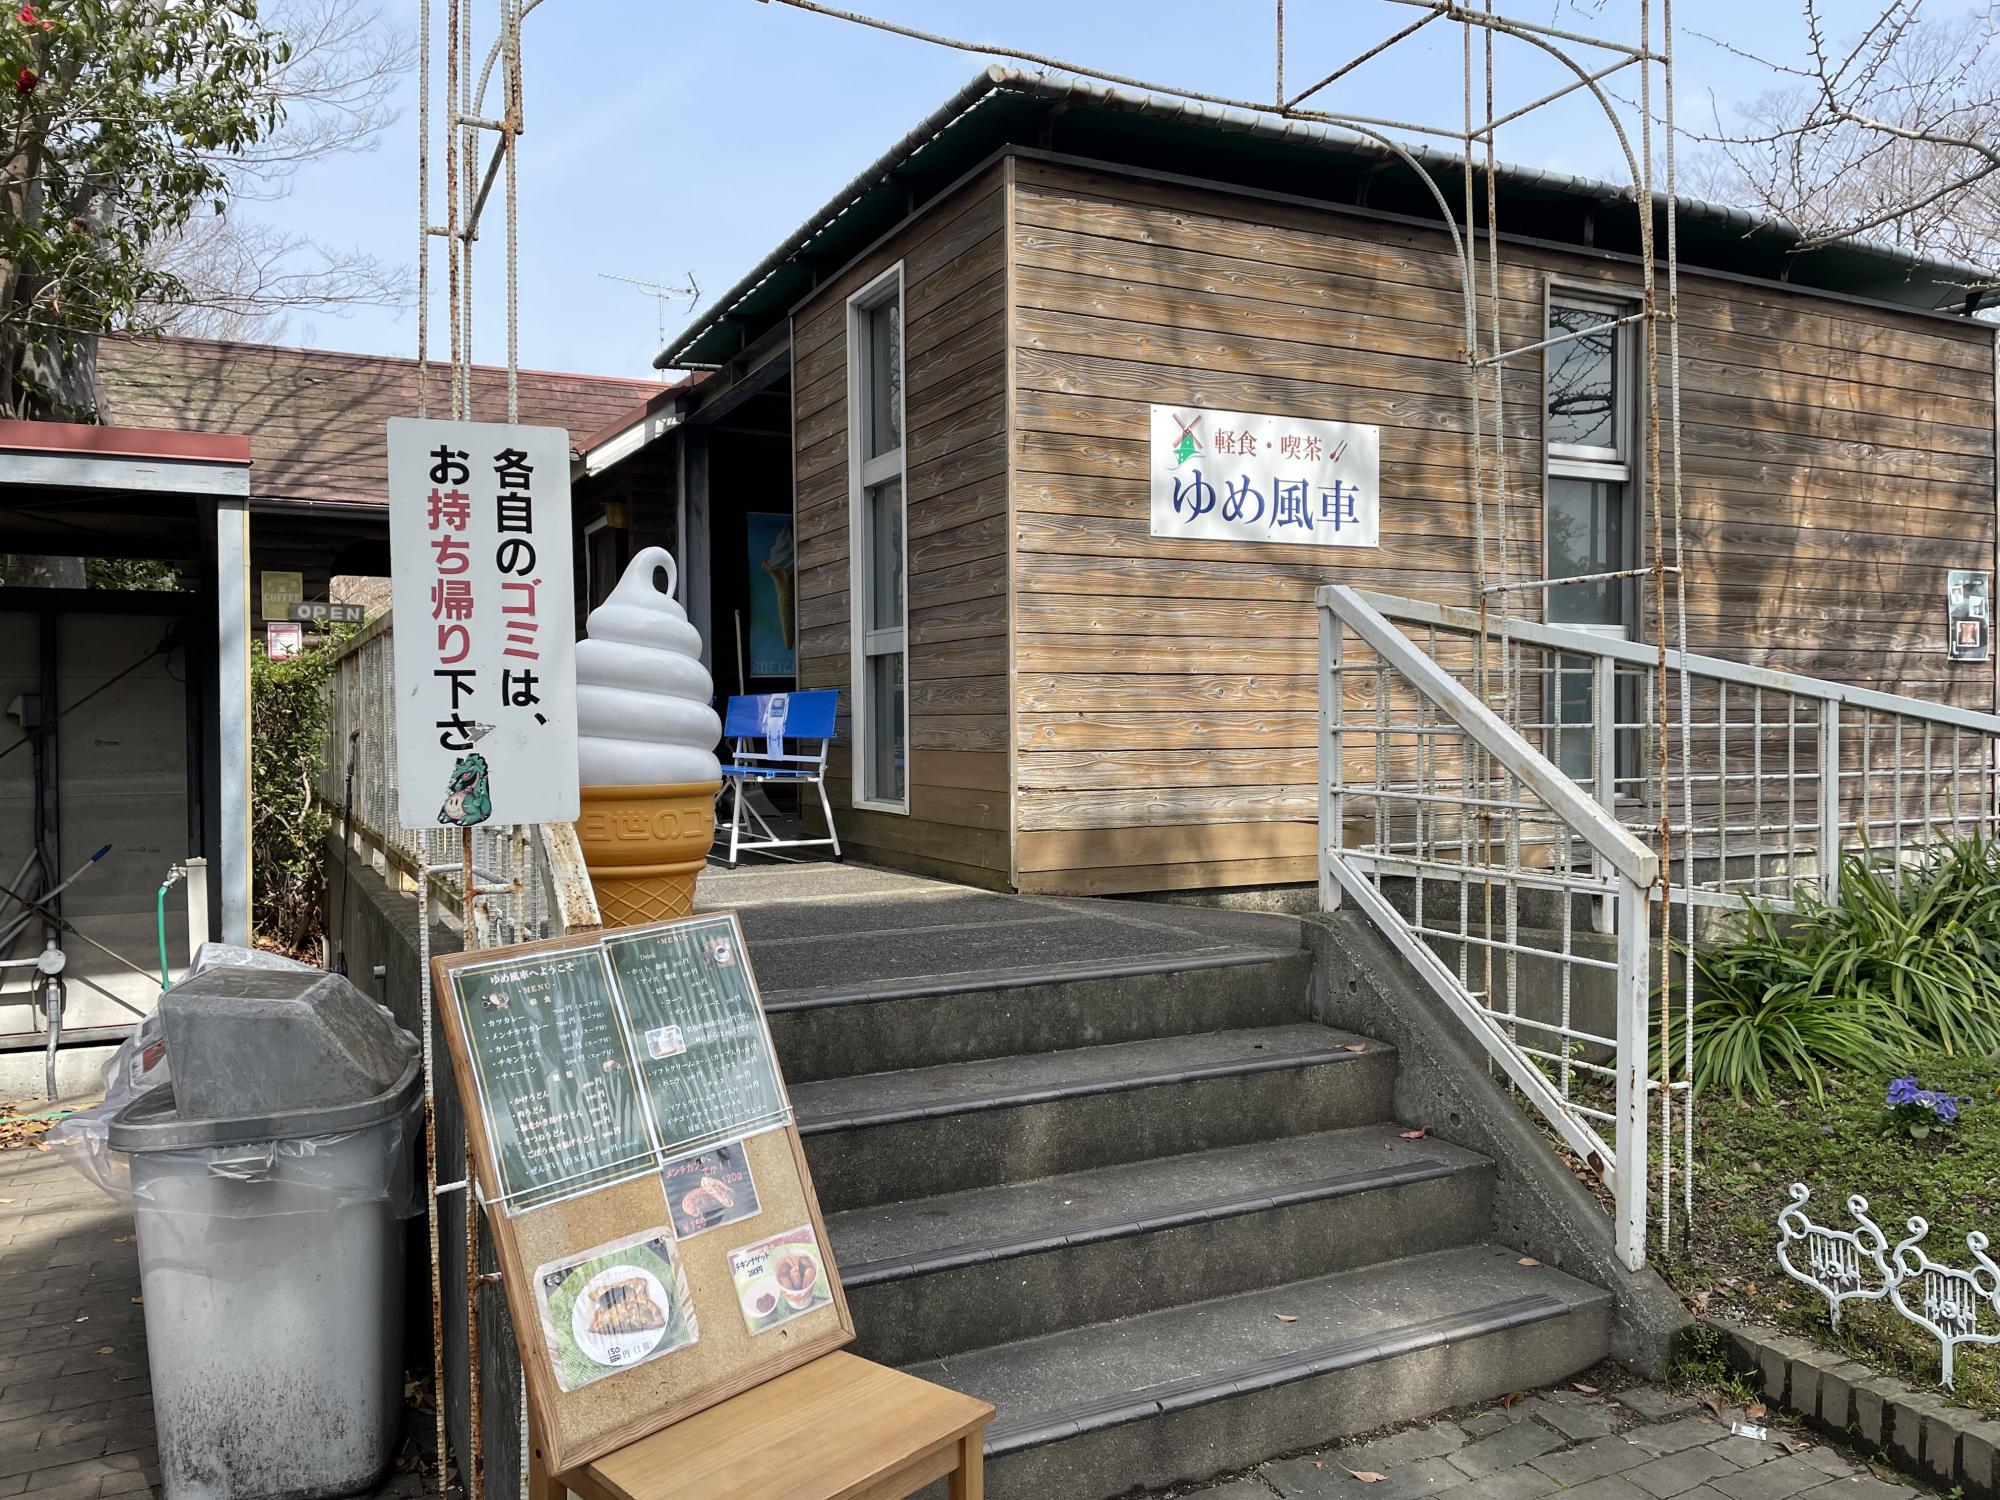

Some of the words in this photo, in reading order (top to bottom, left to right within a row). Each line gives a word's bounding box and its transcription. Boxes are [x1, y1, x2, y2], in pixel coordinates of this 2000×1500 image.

[1214, 428, 1323, 461] 軽食・喫茶
[1172, 469, 1360, 532] ゆめ風車
[297, 604, 360, 621] OPEN
[427, 444, 477, 752] お持ち帰り下さ
[493, 448, 548, 725] 各自のゴミは、
